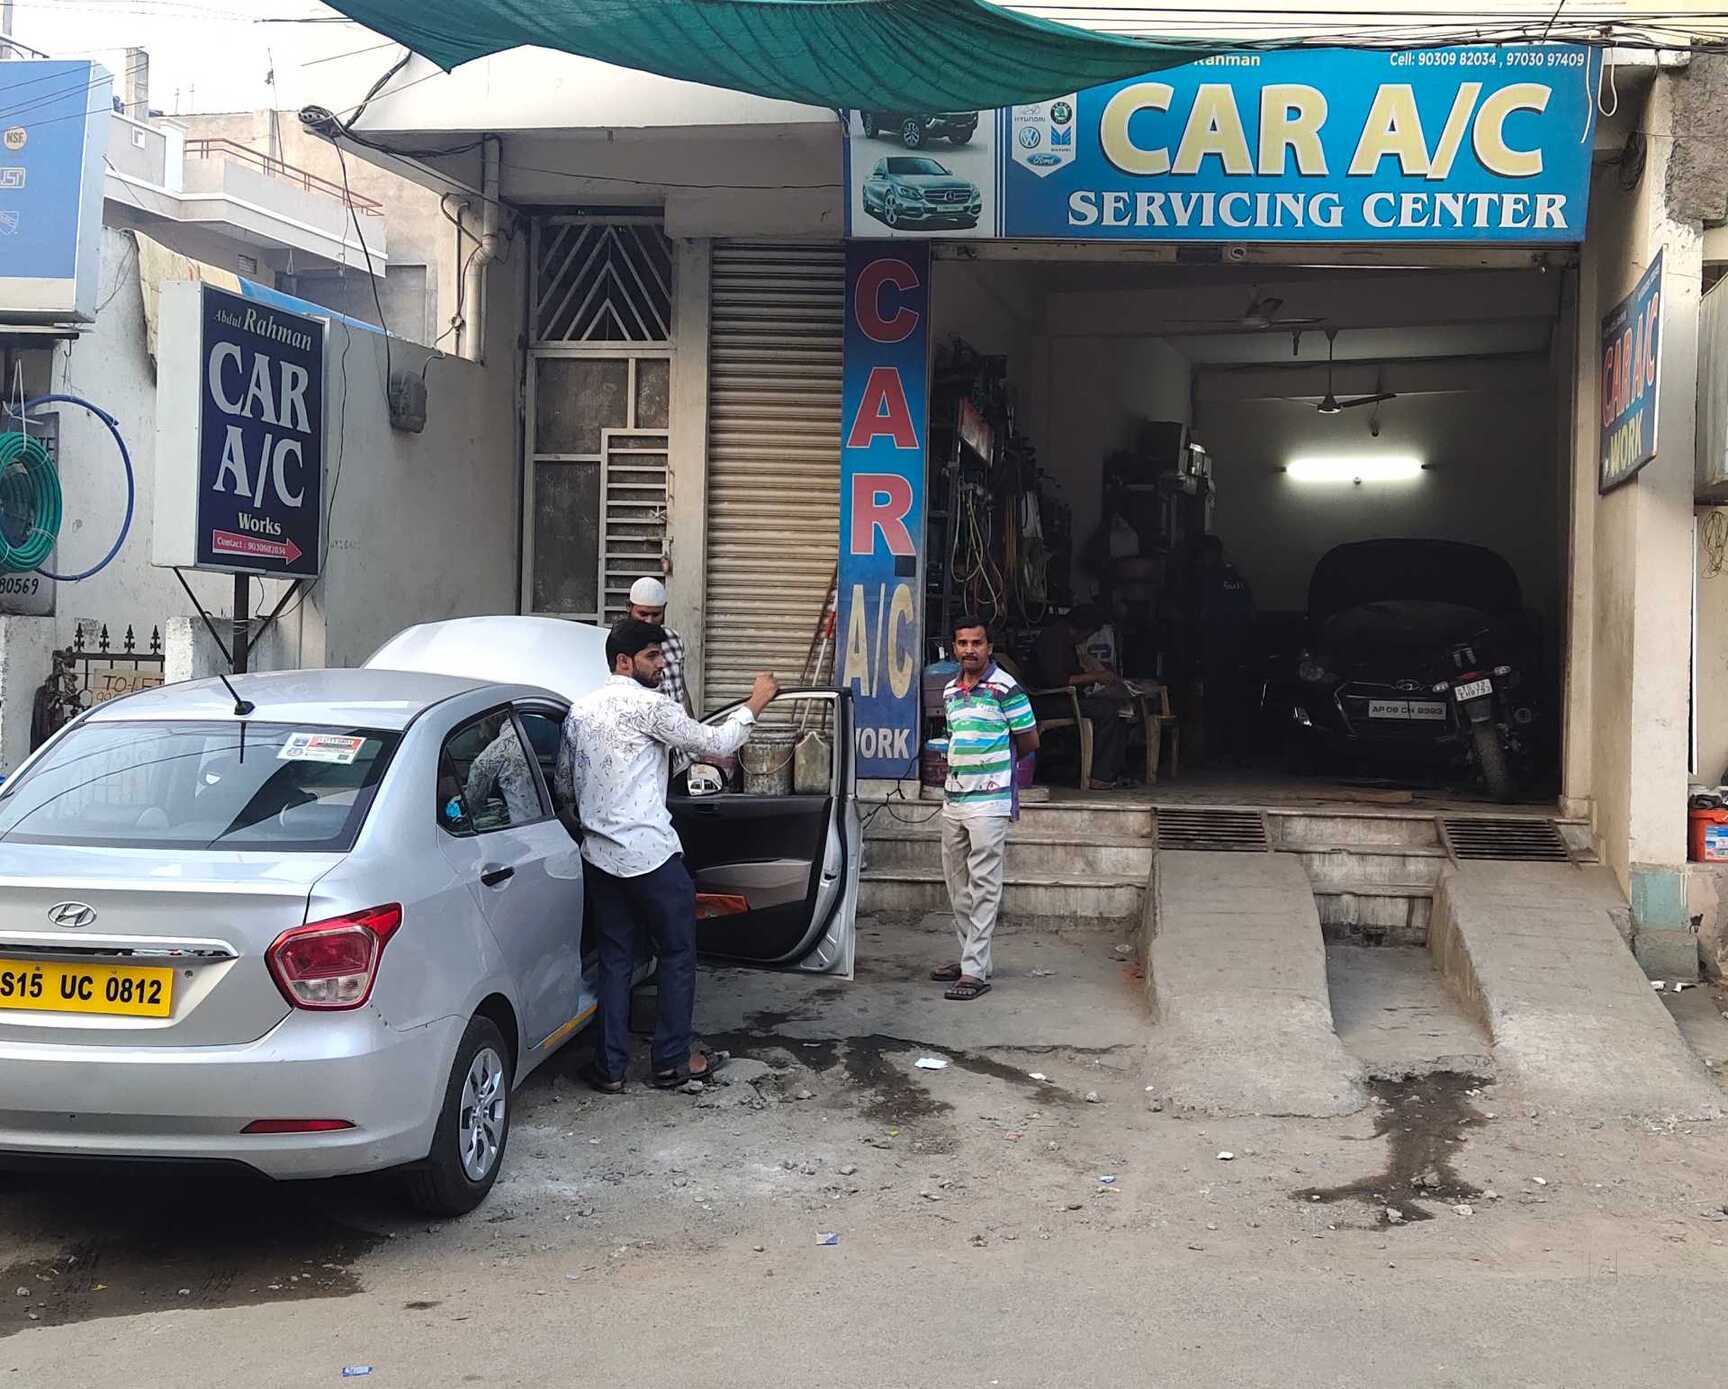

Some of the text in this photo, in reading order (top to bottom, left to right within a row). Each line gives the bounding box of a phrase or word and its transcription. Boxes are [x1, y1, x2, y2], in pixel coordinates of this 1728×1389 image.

[1390, 52, 1415, 66] Cell:
[1418, 52, 1456, 66] 90309
[1459, 53, 1496, 66] 82034
[1506, 53, 1544, 66] 97030
[1547, 53, 1585, 67] 97409
[1100, 82, 1552, 179] CAR A/C
[1068, 190, 1569, 228] SERVICING CENTER
[216, 308, 312, 351] Abdul Rahman
[208, 341, 312, 433] CAR
[846, 258, 920, 556] CAR
[1601, 325, 1634, 428] CAR
[212, 424, 305, 508] A/C
[1610, 408, 1644, 478] WORK
[217, 537, 242, 549] Contact
[238, 512, 281, 535] Works
[843, 582, 914, 699] A/C
[0, 971, 162, 1004] S15 UC 0812
